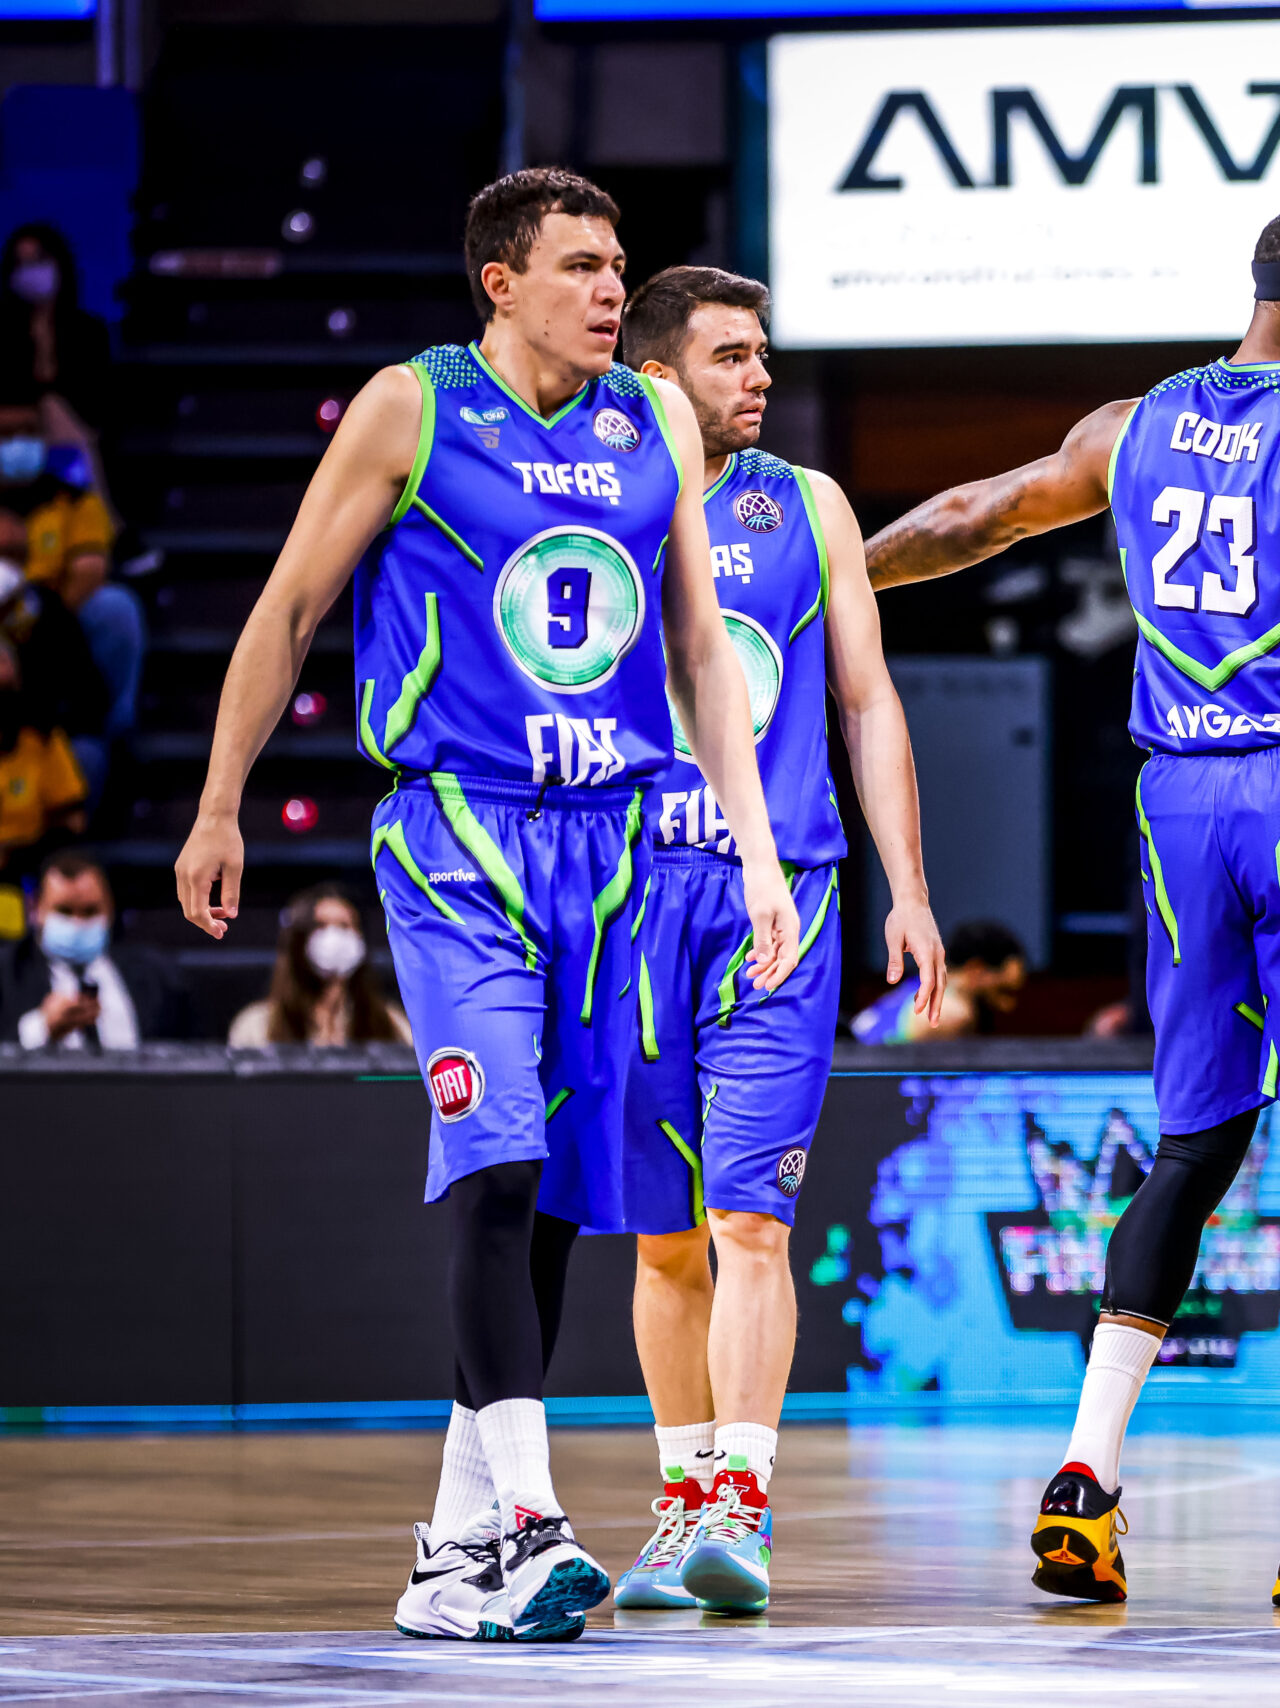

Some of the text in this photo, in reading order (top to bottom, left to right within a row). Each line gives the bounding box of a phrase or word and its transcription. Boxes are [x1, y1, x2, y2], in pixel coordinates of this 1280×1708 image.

[1170, 411, 1264, 464] COOK
[511, 461, 622, 505] TOFAŞ
[1151, 485, 1259, 617] 23
[547, 567, 592, 649] 9
[525, 713, 626, 787] FIAT
[659, 785, 743, 857] FIA
[429, 868, 476, 885] sportive
[432, 1065, 468, 1107] FIAT
